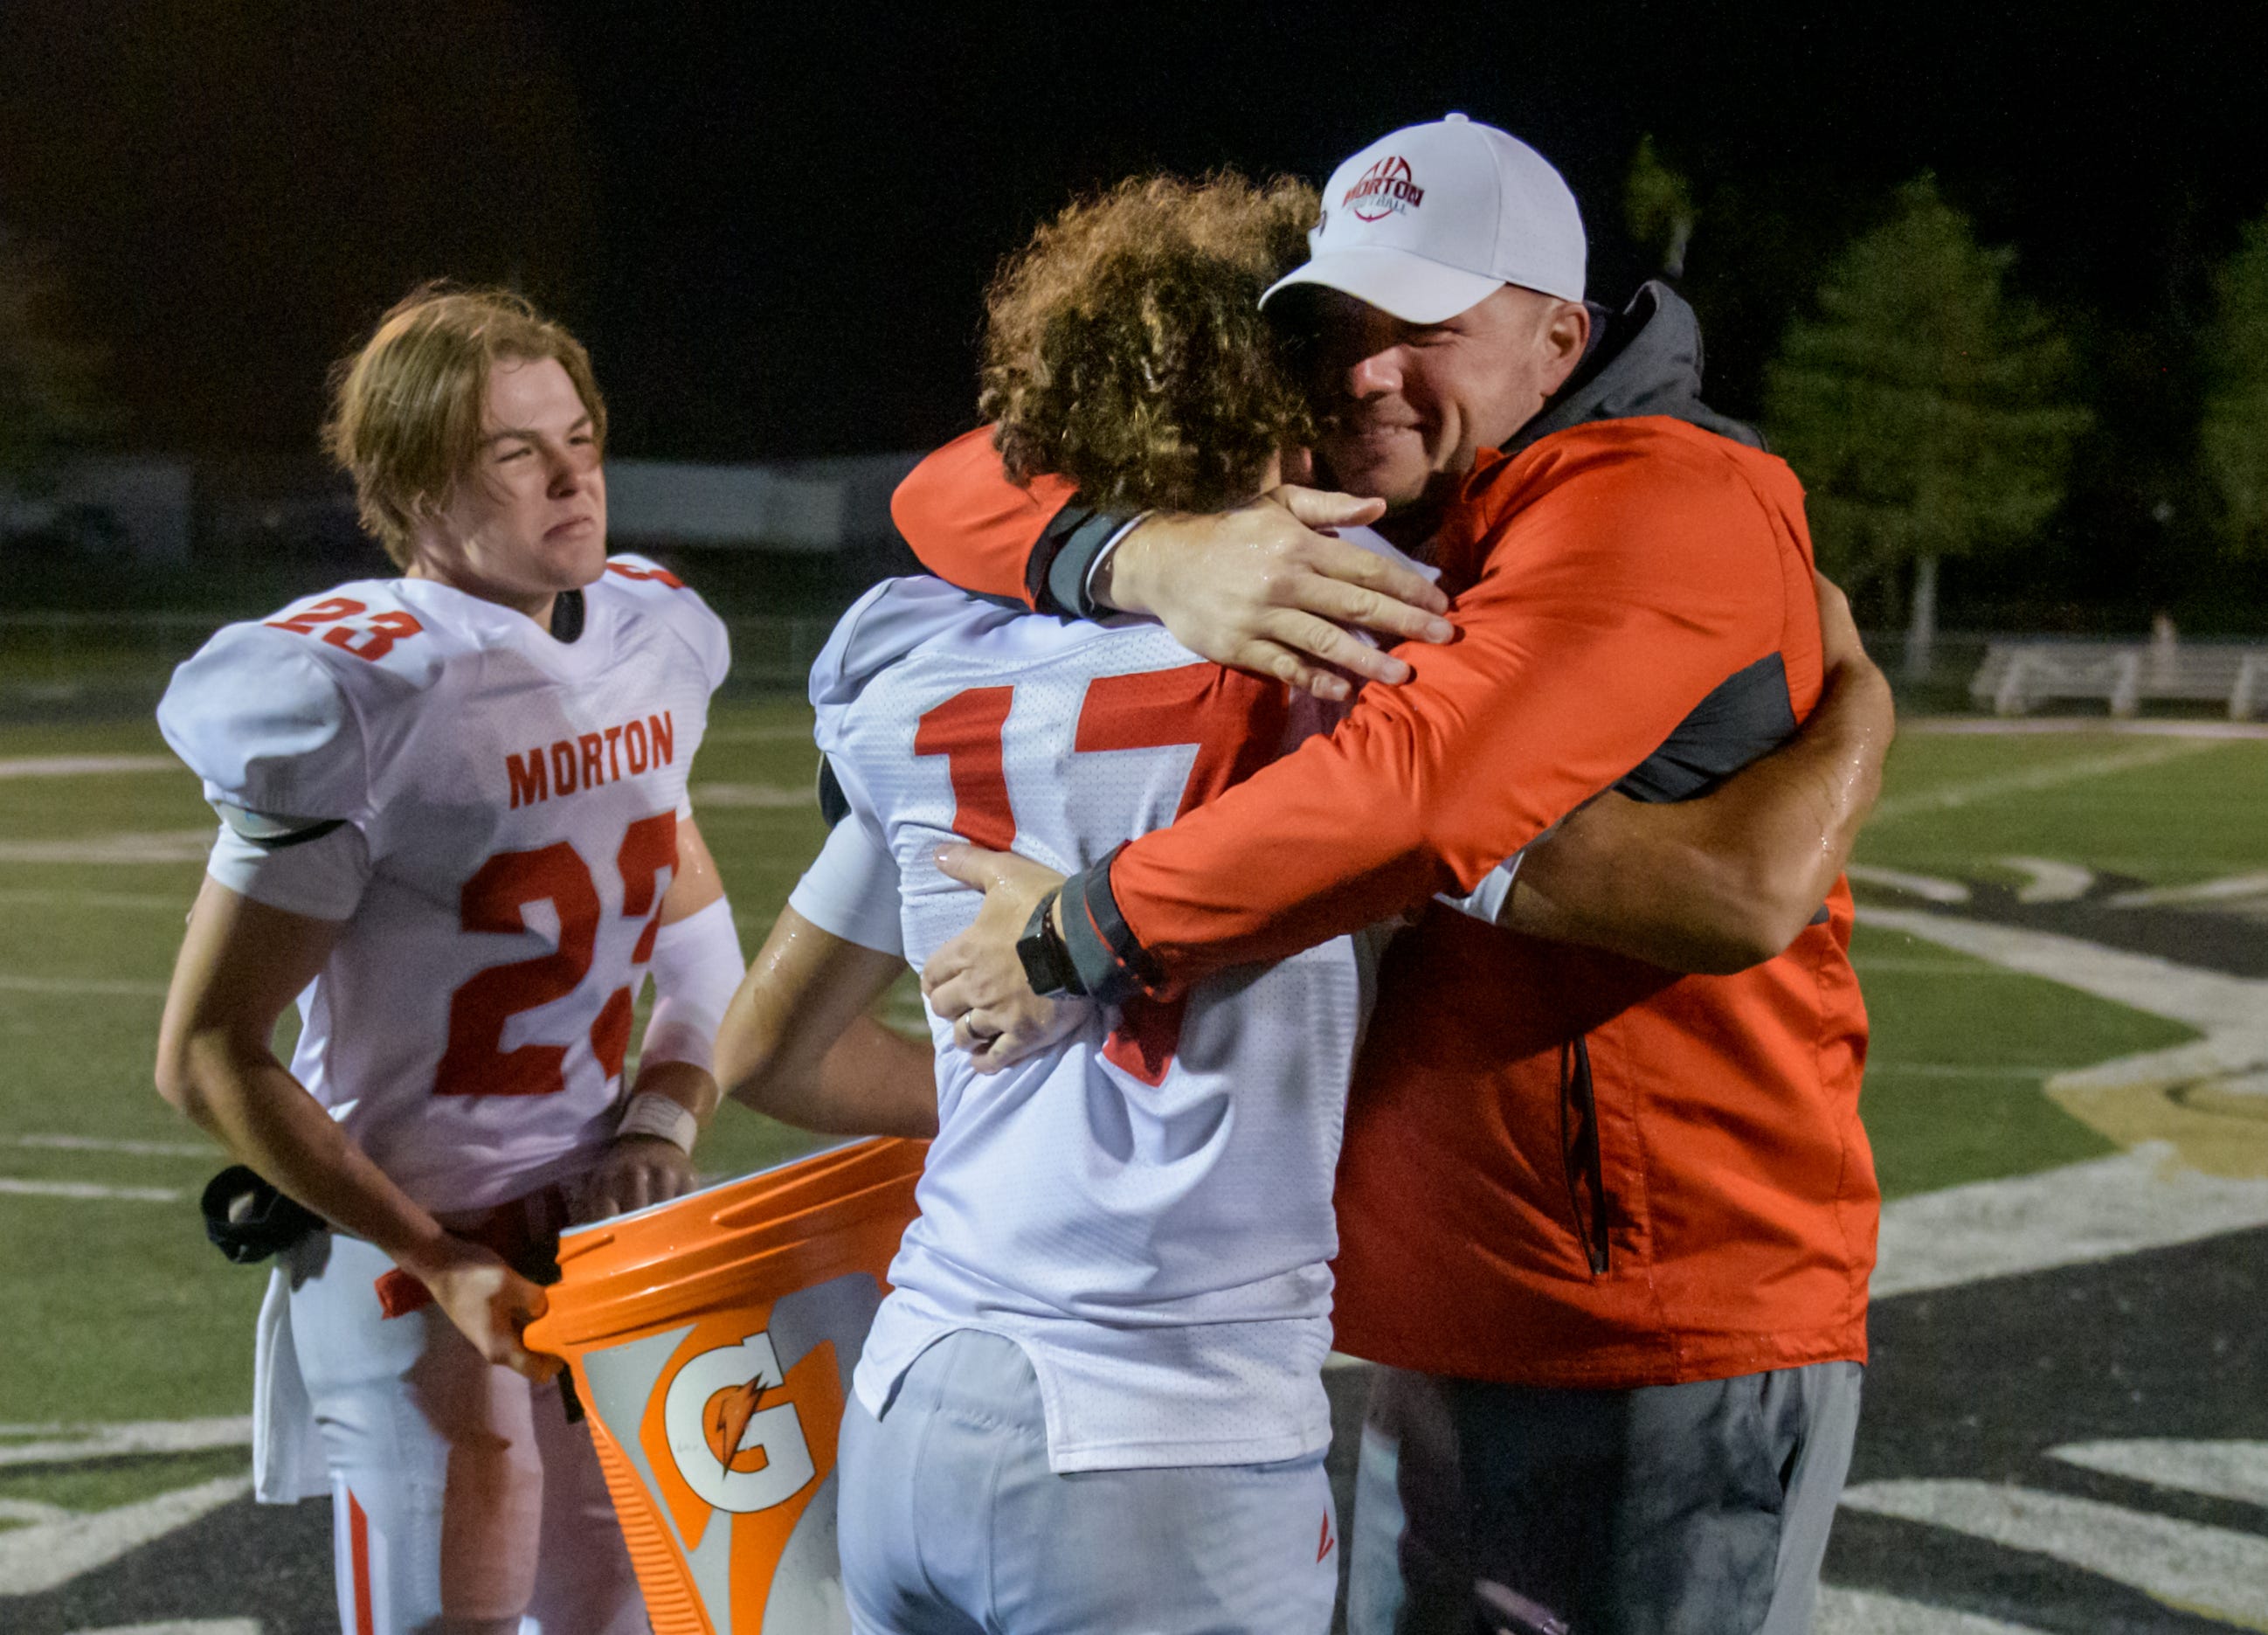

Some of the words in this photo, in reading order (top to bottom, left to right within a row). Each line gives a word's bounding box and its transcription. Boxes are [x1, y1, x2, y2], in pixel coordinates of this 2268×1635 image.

[1342, 177, 1424, 208] MORTON
[265, 597, 424, 662] 23
[506, 710, 674, 810] MORTON
[664, 1330, 816, 1514] G
